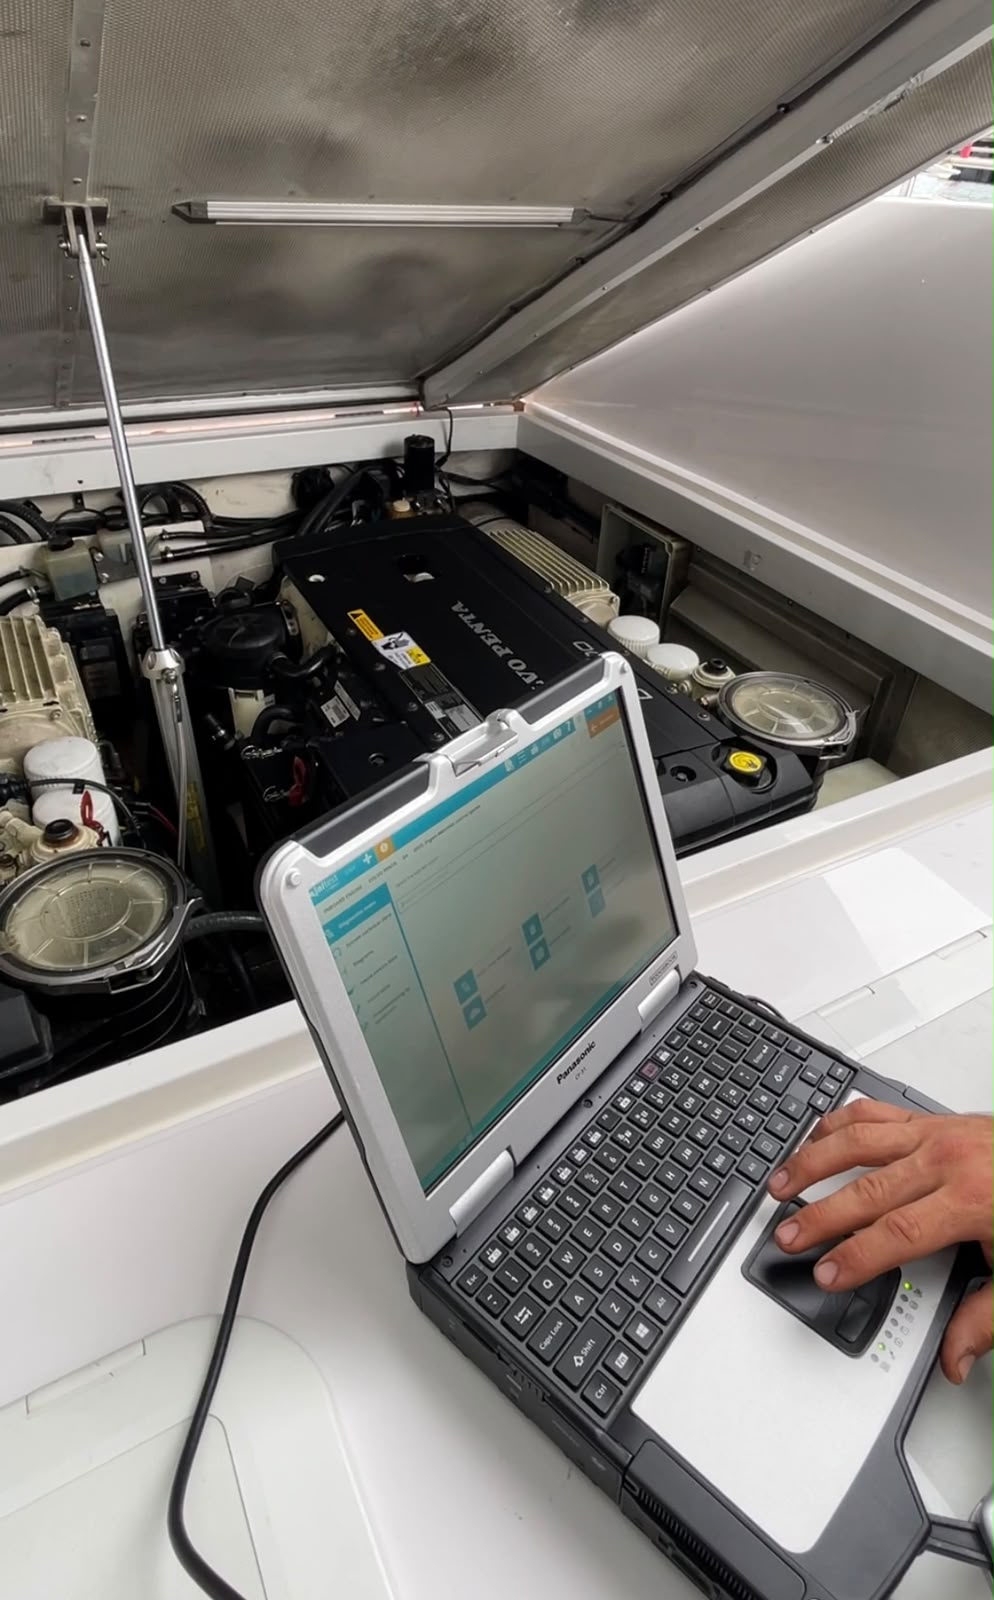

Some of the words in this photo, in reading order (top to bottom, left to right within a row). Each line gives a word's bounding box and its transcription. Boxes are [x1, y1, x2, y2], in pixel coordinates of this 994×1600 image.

[451, 600, 514, 657] PENTA
[508, 658, 544, 690] VO
[556, 1040, 596, 1084] Panasonic
[695, 1132, 704, 1140] K
[651, 1140, 661, 1149] U
[681, 1152, 689, 1160] J
[636, 1158, 646, 1166] Y
[712, 1159, 721, 1168] M
[665, 1171, 676, 1181] H
[620, 1181, 628, 1189] T
[698, 1178, 709, 1188] N
[649, 1194, 659, 1203] G
[601, 1204, 612, 1213] R
[682, 1201, 692, 1210] B
[631, 1217, 640, 1226] F
[583, 1228, 592, 1237] E
[665, 1224, 675, 1234] V
[612, 1242, 622, 1252] D
[532, 1249, 541, 1257] 2
[561, 1251, 575, 1264] W
[648, 1249, 658, 1259] C
[594, 1267, 603, 1277] S
[466, 1274, 478, 1286] Esc
[542, 1279, 554, 1289] Q
[629, 1275, 640, 1286] X
[574, 1295, 584, 1305] A
[656, 1297, 667, 1308] Alt
[610, 1302, 620, 1313] Z
[539, 1336, 552, 1350] Caps
[550, 1321, 563, 1339] Lock
[581, 1339, 596, 1357] Shift
[594, 1383, 608, 1399] Ctrl
